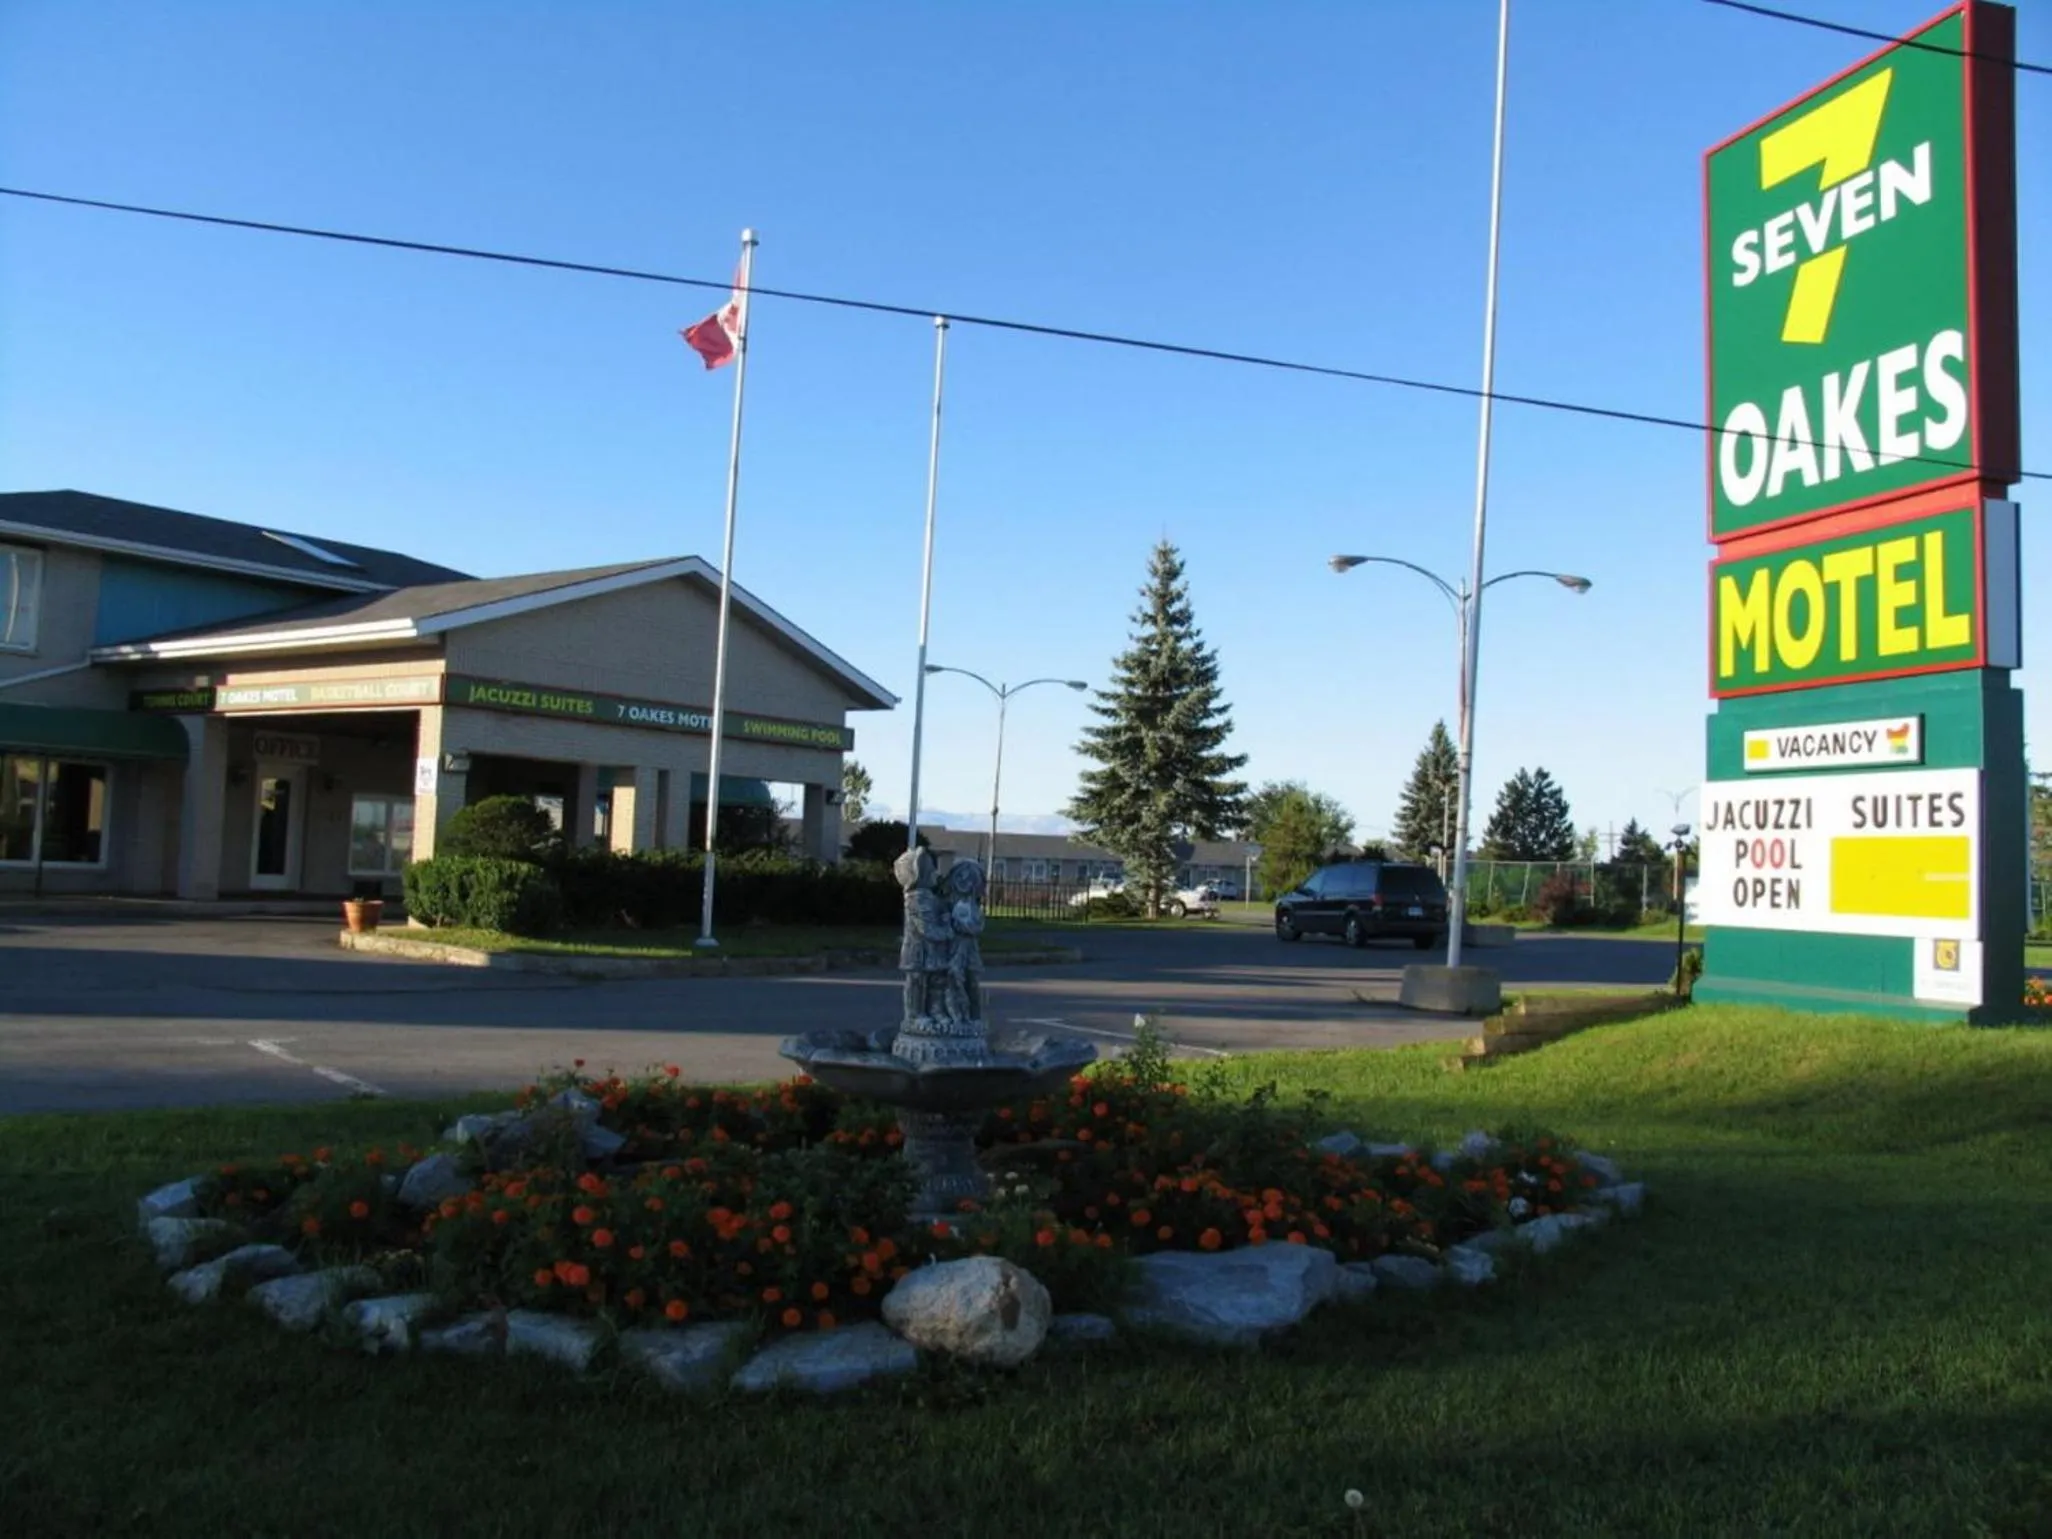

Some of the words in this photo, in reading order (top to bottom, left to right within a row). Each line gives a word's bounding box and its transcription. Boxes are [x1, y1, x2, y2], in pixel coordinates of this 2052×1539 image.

[1732, 141, 1932, 287] SEVEN
[1760, 67, 1893, 345] 7
[1718, 329, 1968, 507] OAKES
[1719, 530, 1971, 678] MOTEL
[469, 685, 537, 709] JACUZZI
[540, 694, 594, 715] SUITES
[617, 704, 625, 718] 7
[628, 707, 674, 726] OAKES
[743, 718, 809, 741] SWIMMING
[811, 727, 843, 746] POOL
[1777, 729, 1878, 759] VACANCY
[1705, 797, 1813, 831] JACUZZI
[1851, 792, 1966, 829] SUITES
[1735, 838, 1803, 870] POOL
[1733, 877, 1801, 910] OPEN
